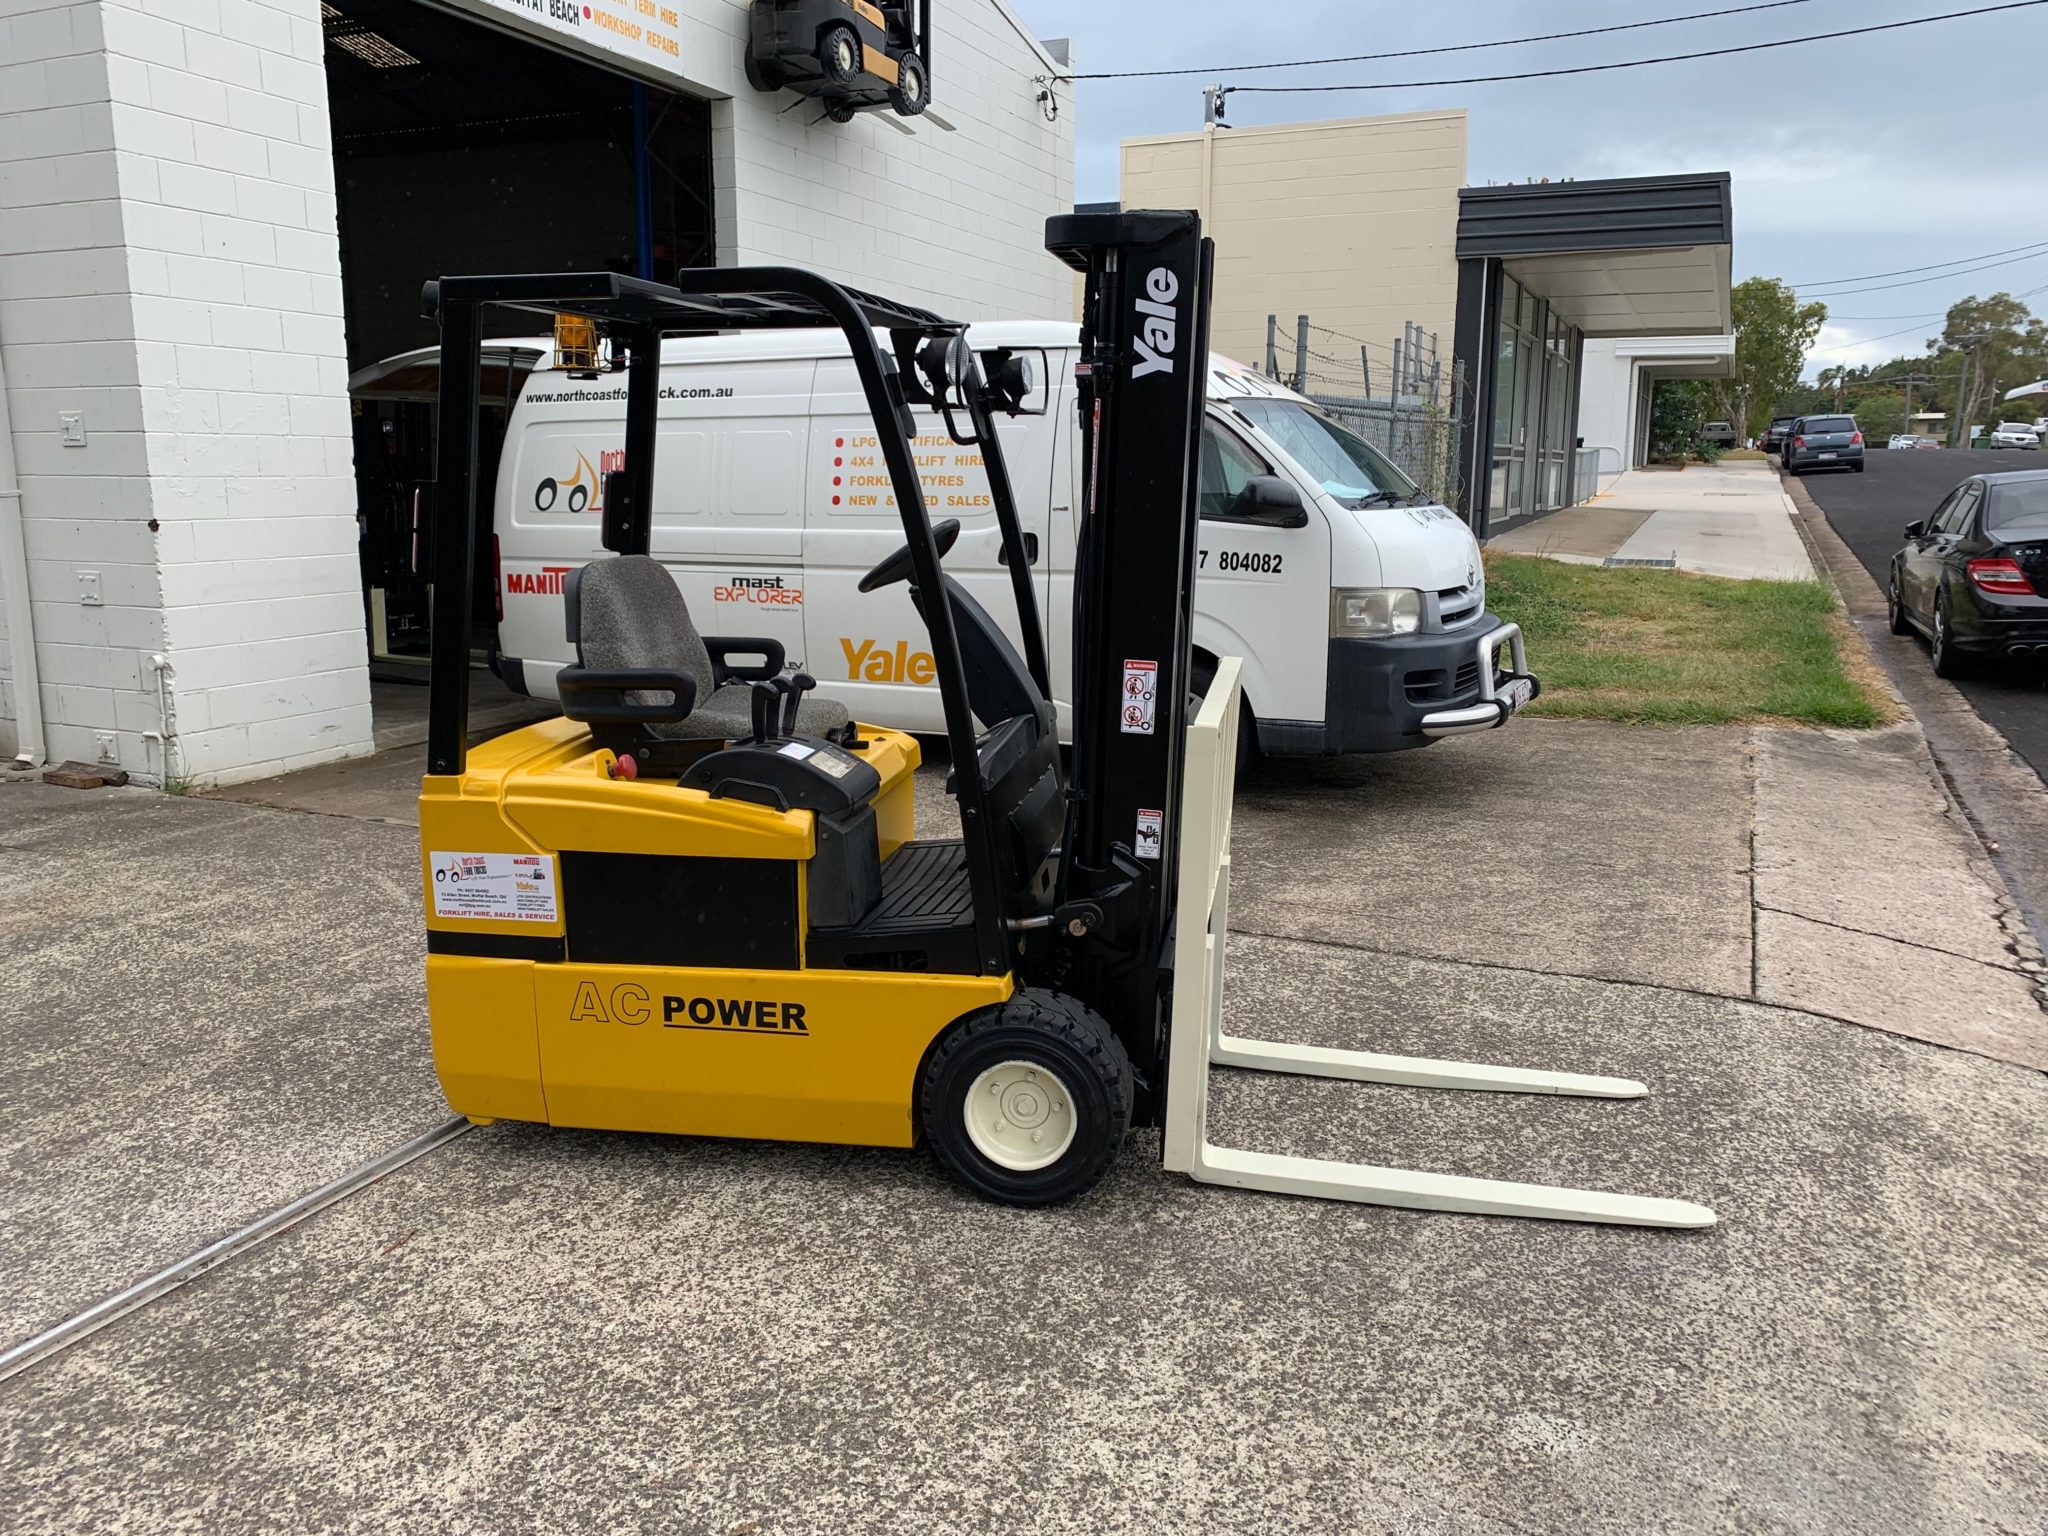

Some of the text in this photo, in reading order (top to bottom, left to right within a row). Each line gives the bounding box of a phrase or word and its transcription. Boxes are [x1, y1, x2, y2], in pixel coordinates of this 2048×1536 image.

[550, 0, 580, 26] BEACH
[660, 6, 679, 28] HIRE
[593, 8, 680, 57] WORKSHOP REPAIRS
[1131, 267, 1179, 379] Yale
[852, 437, 877, 448] LPG
[850, 456, 875, 467] 4X4
[849, 475, 964, 487] FORKL TYRES
[849, 495, 878, 507] NEW
[885, 495, 895, 506] &
[947, 495, 990, 507] SALES
[1219, 551, 1284, 574] 804082
[732, 576, 784, 589] mast
[714, 587, 803, 605] EXPLORER
[839, 638, 938, 685] Yale
[513, 857, 540, 865] MANITOU
[570, 981, 808, 1031] AC POWER
